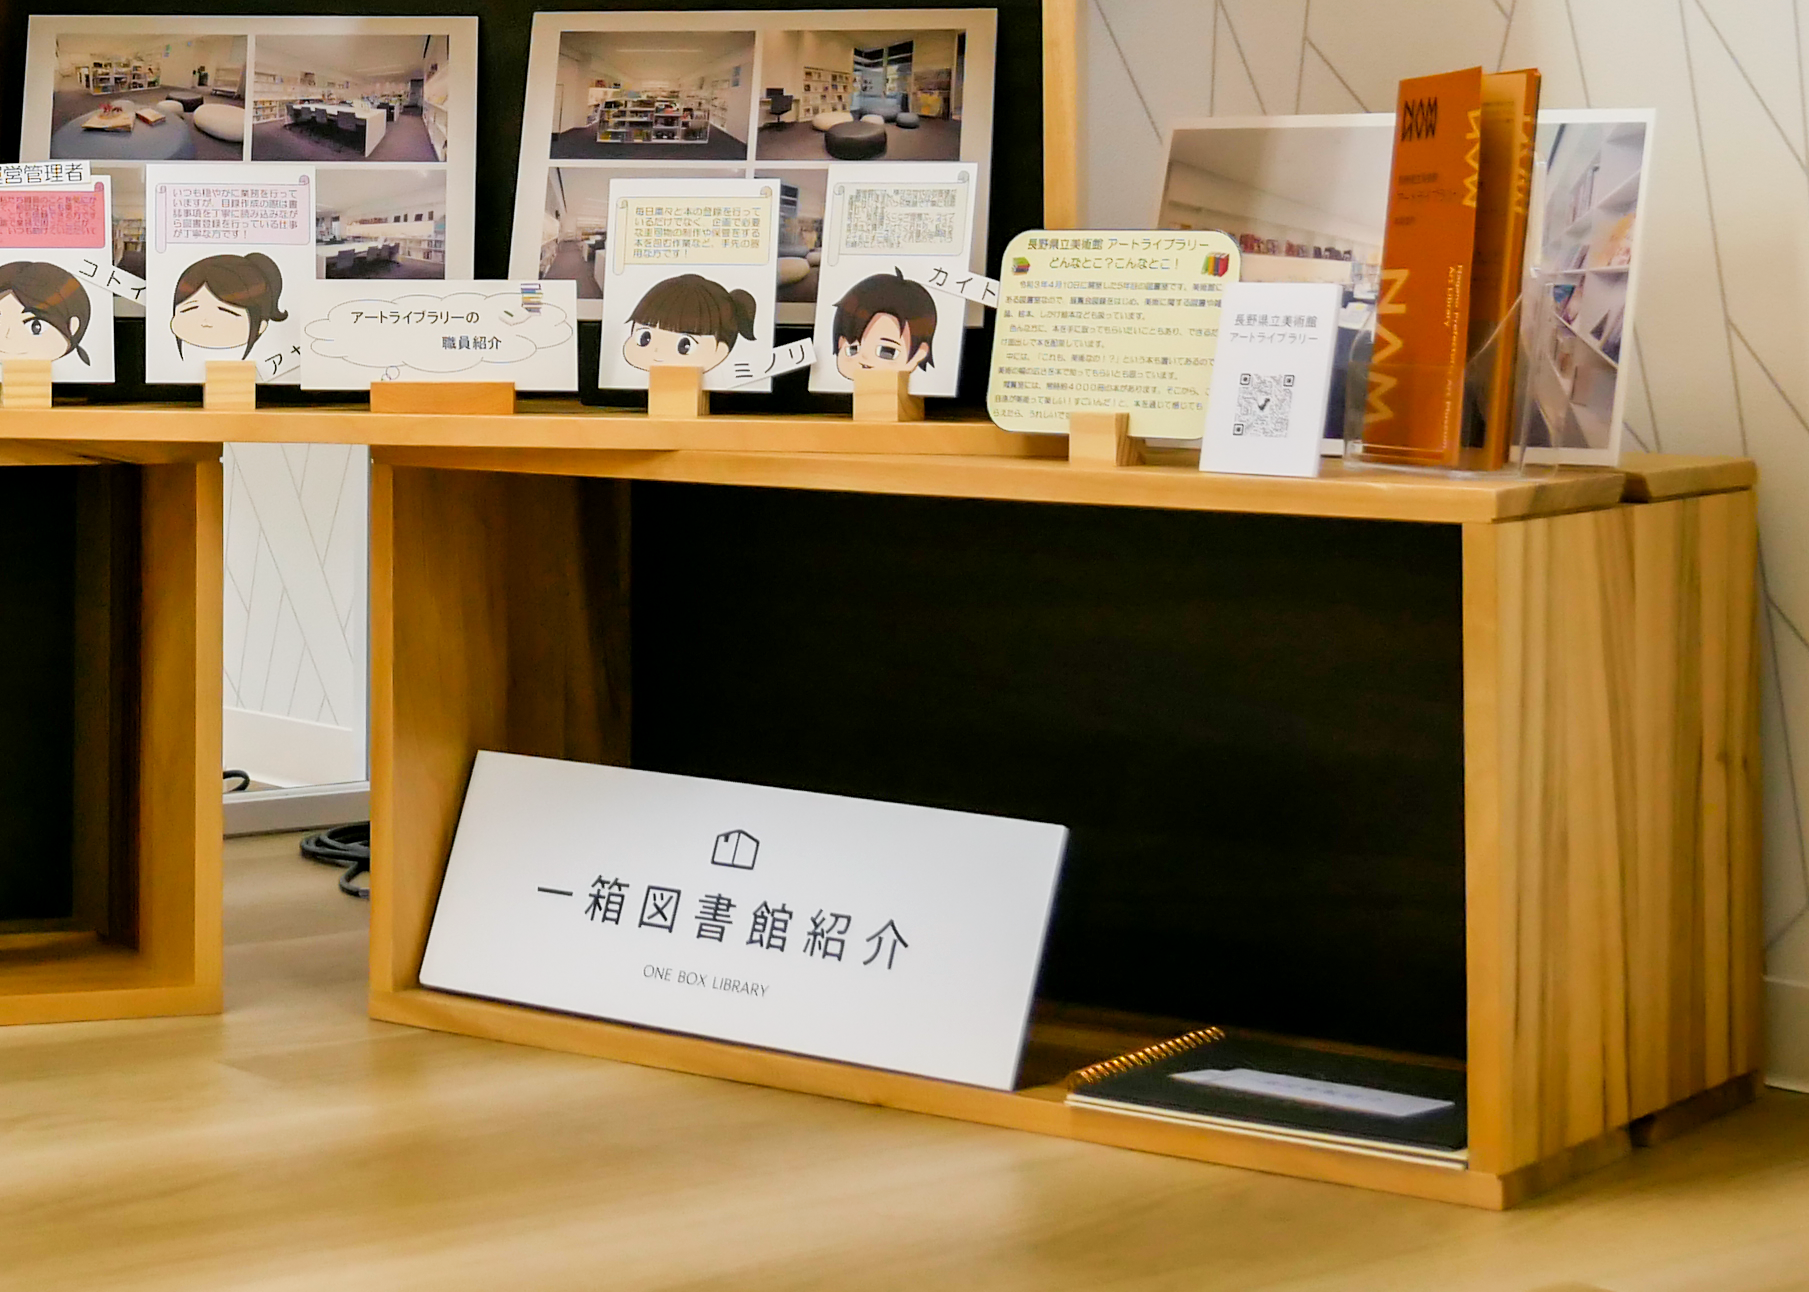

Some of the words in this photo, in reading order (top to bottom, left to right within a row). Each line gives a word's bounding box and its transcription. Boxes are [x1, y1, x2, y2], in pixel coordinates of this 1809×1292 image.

[1027, 238, 1103, 250] 長野県立美術館
[1108, 239, 1209, 250] アートライブラリー
[928, 267, 996, 301] カイト
[351, 311, 480, 325] アートライブラリーの
[1235, 315, 1318, 328] 長野県立美術館
[441, 336, 502, 350] 職員紹介
[1230, 332, 1318, 344] アートライブラリー
[1363, 268, 1411, 425] NAM
[733, 344, 806, 379] ミノリ
[536, 874, 909, 970] 一箱図書館紹介
[643, 964, 673, 984] ONE
[677, 970, 708, 988] BOX
[712, 976, 770, 998] LIBRARY
